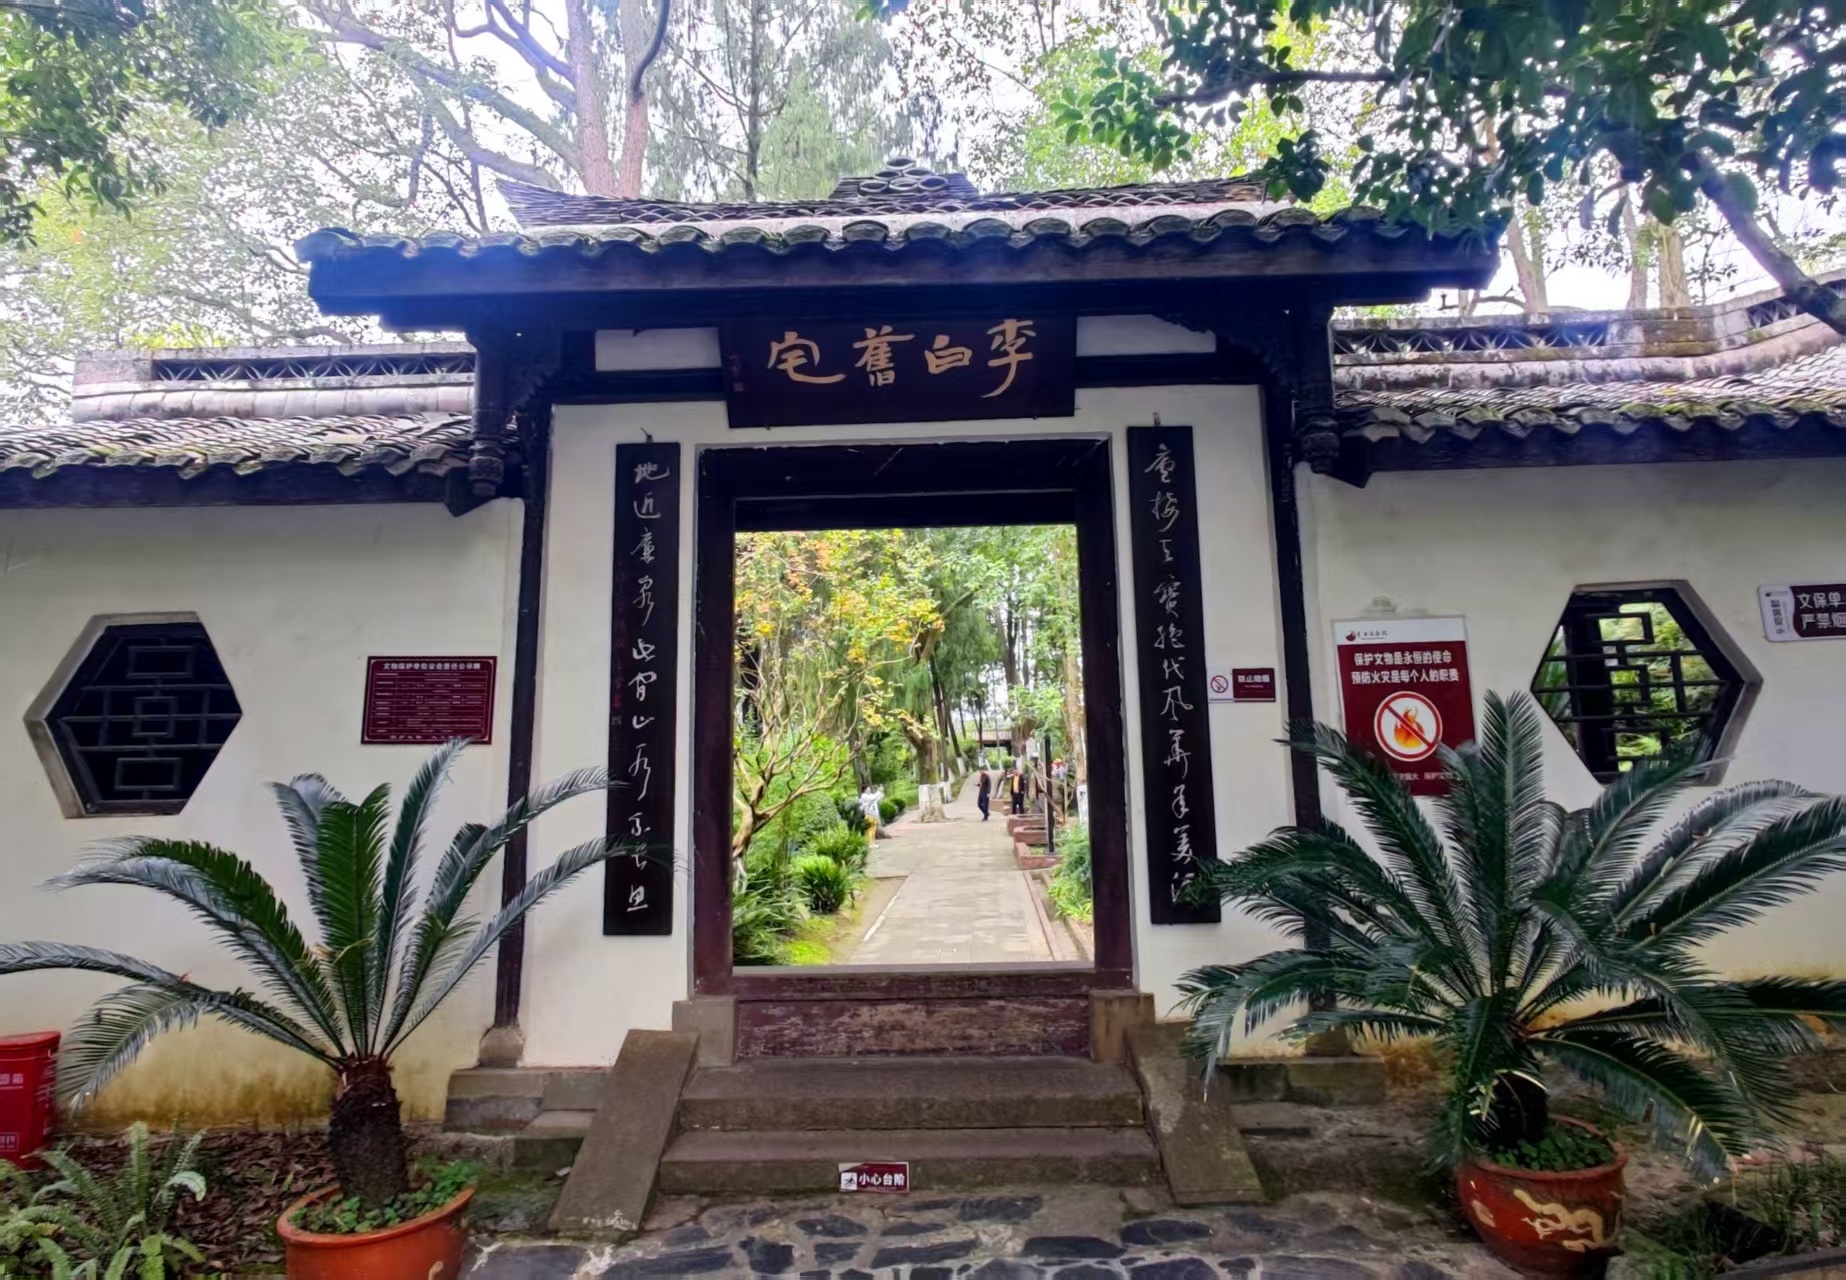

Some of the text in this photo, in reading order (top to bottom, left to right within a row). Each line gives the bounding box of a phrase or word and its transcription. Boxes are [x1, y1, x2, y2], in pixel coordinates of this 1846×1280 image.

[1796, 591, 1846, 609] 文保单
[1354, 649, 1452, 667] 保护文物是永恒的使命
[1351, 668, 1459, 685] 预防火灾是每个人的职责
[859, 1172, 905, 1186] 小心台阶
